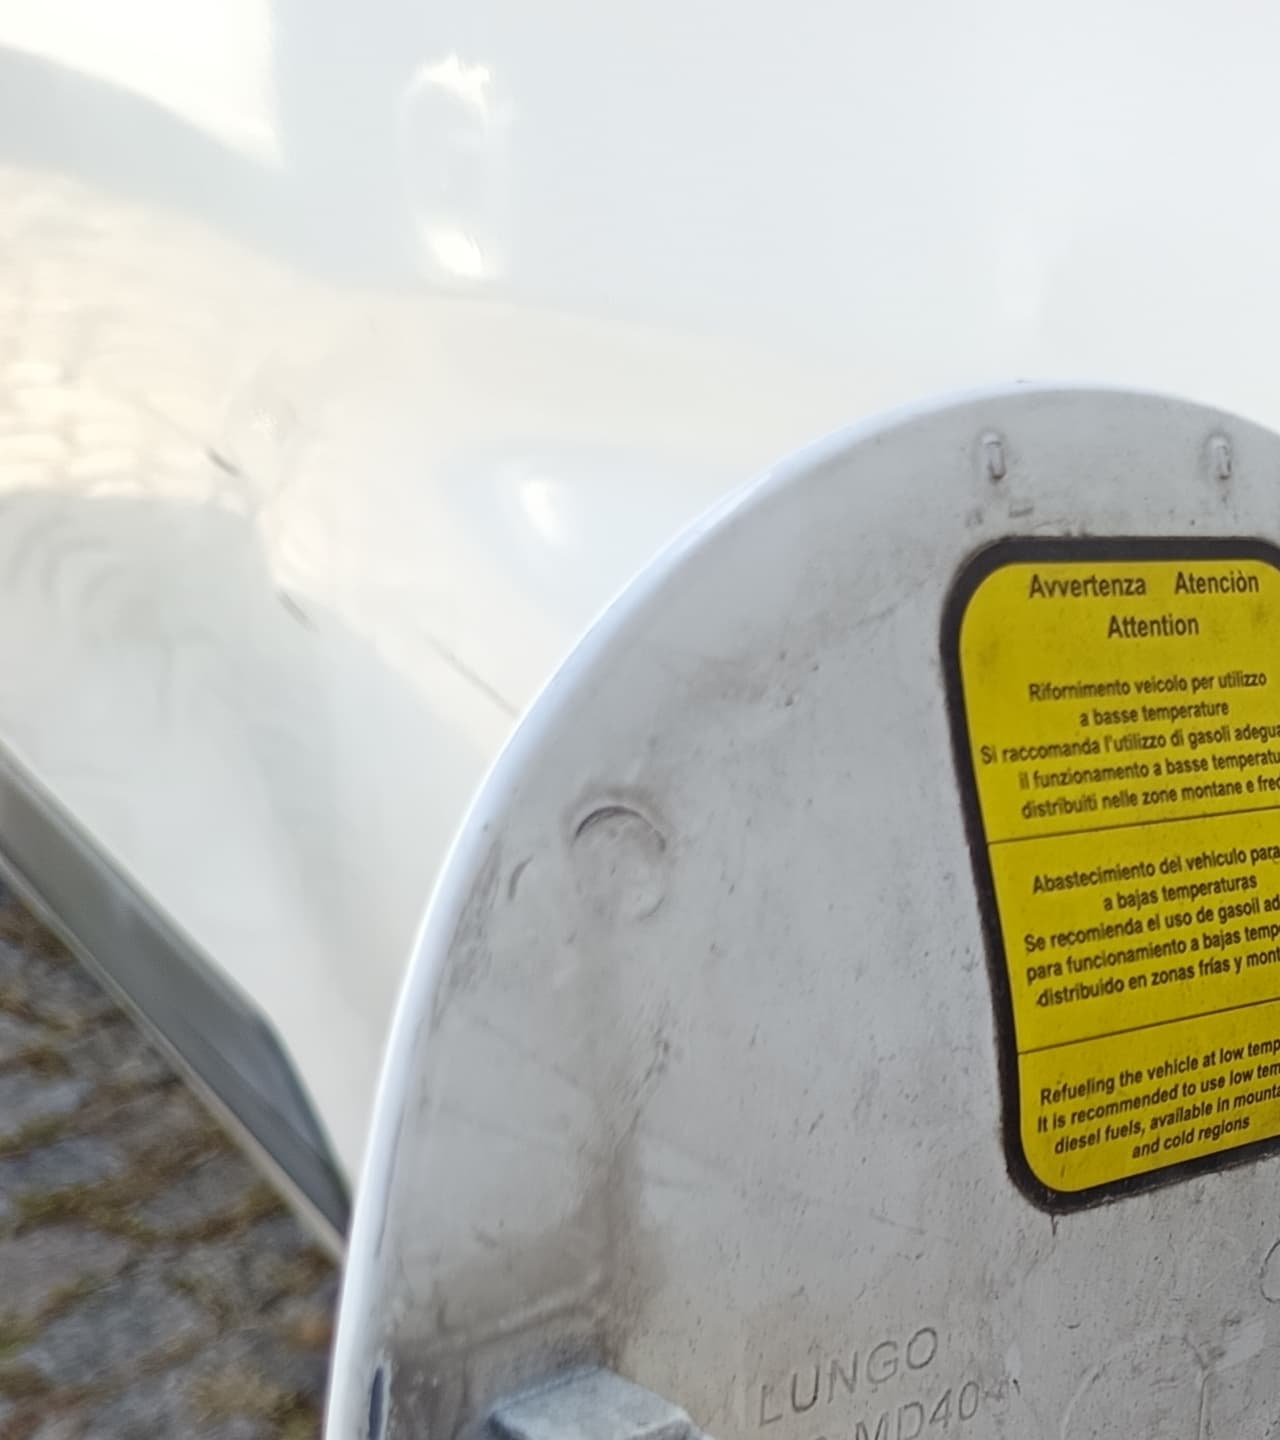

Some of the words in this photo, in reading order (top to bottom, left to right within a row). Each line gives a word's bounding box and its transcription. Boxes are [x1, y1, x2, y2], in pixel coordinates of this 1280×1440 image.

[1029, 574, 1146, 598] Avvertenza
[1107, 615, 1199, 639] Attention
[1029, 682, 1130, 701] Rifornimento
[1135, 676, 1187, 693] veicolo
[1192, 677, 1214, 694] per
[1218, 671, 1267, 689] utilizzo
[1080, 713, 1088, 726] a
[1093, 708, 1138, 726] basse
[1142, 702, 1229, 724] temperature
[981, 745, 996, 765] Si
[1003, 740, 1100, 762] raccomanda
[1170, 731, 1184, 748] di
[1188, 725, 1230, 750] gasoli
[1034, 763, 1149, 788] funzionamento
[1154, 763, 1162, 776] a
[1166, 757, 1208, 774] basse
[1102, 790, 1138, 809] nelle
[1142, 787, 1177, 805] zone
[1181, 780, 1242, 799] montane
[1246, 781, 1254, 793] e
[1032, 860, 1155, 895] Abastecimiento
[1159, 857, 1182, 876] del
[1251, 846, 1280, 866] para
[1104, 897, 1113, 911] a
[1117, 890, 1159, 911] bajas
[1162, 875, 1257, 901] temperaturas
[1024, 934, 1045, 953] Se
[1050, 918, 1143, 949] recomienda
[1148, 915, 1160, 931] el
[1165, 913, 1192, 928] uso
[1196, 907, 1214, 923] de
[1219, 897, 1260, 923] gasoil
[1026, 963, 1062, 985] para
[1067, 939, 1186, 975] funcionamiento
[1190, 938, 1199, 952] a
[1203, 929, 1241, 951] bajas
[1038, 976, 1124, 1007] distribuido
[1128, 974, 1147, 989] en
[1151, 965, 1195, 986] zonas
[1234, 958, 1243, 973] y
[1041, 1076, 1115, 1105] Refueling
[1119, 1070, 1143, 1089] the
[1147, 1054, 1198, 1081] vehicle
[1203, 1053, 1216, 1068] at
[1220, 1047, 1244, 1065] low
[1038, 1117, 1048, 1132] It
[1053, 1113, 1066, 1129] is
[1071, 1088, 1178, 1123] recommended
[1182, 1081, 1197, 1097] to
[1201, 1077, 1226, 1093] use
[1230, 1066, 1254, 1086] low
[1055, 1129, 1101, 1155] diesel
[1104, 1118, 1146, 1141] fuels,
[1150, 1101, 1213, 1131] available
[1217, 1095, 1230, 1113] in
[1132, 1138, 1160, 1159] and
[1165, 1128, 1195, 1153] cold
[1199, 1116, 1250, 1143] regions
[759, 1327, 938, 1426] LUNGO
